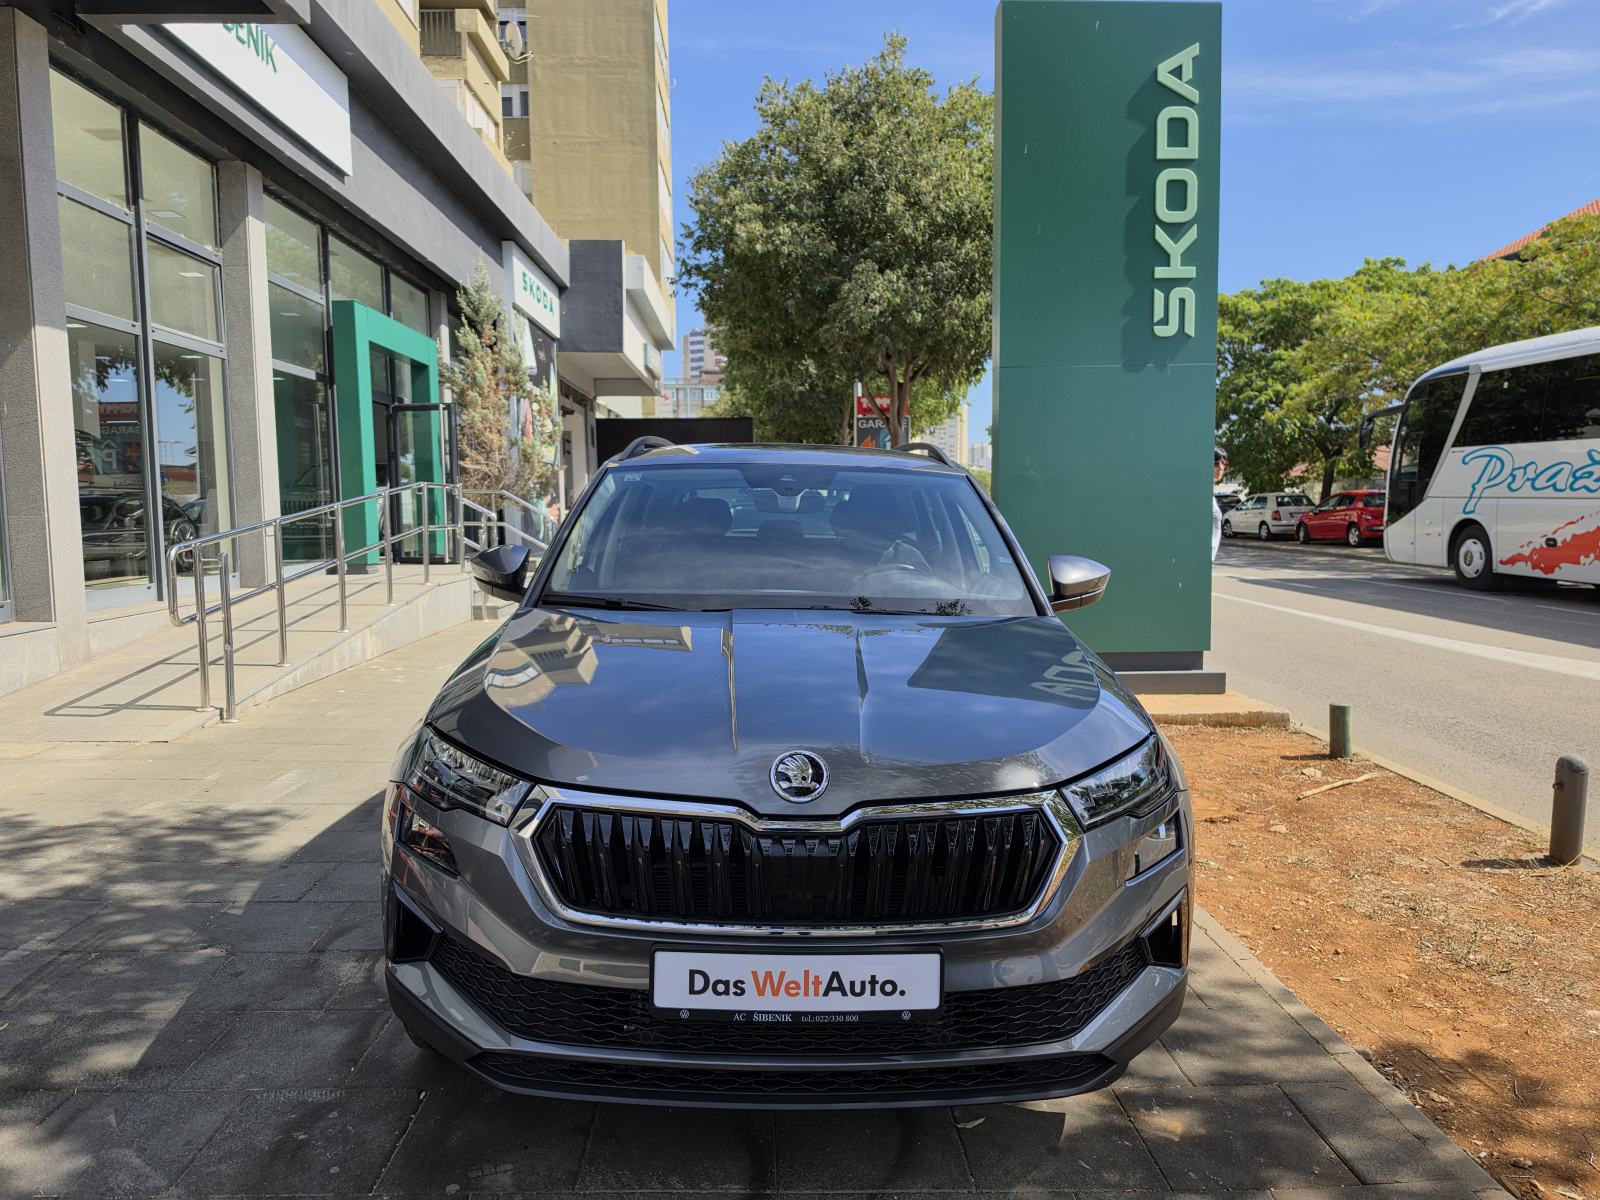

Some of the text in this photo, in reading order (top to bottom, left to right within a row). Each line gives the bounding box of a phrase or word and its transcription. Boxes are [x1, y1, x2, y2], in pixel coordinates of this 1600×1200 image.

[688, 968, 906, 998] Das WeltAuto.
[733, 1012, 747, 1022] AC
[753, 1012, 792, 1022] ŠIBENIK
